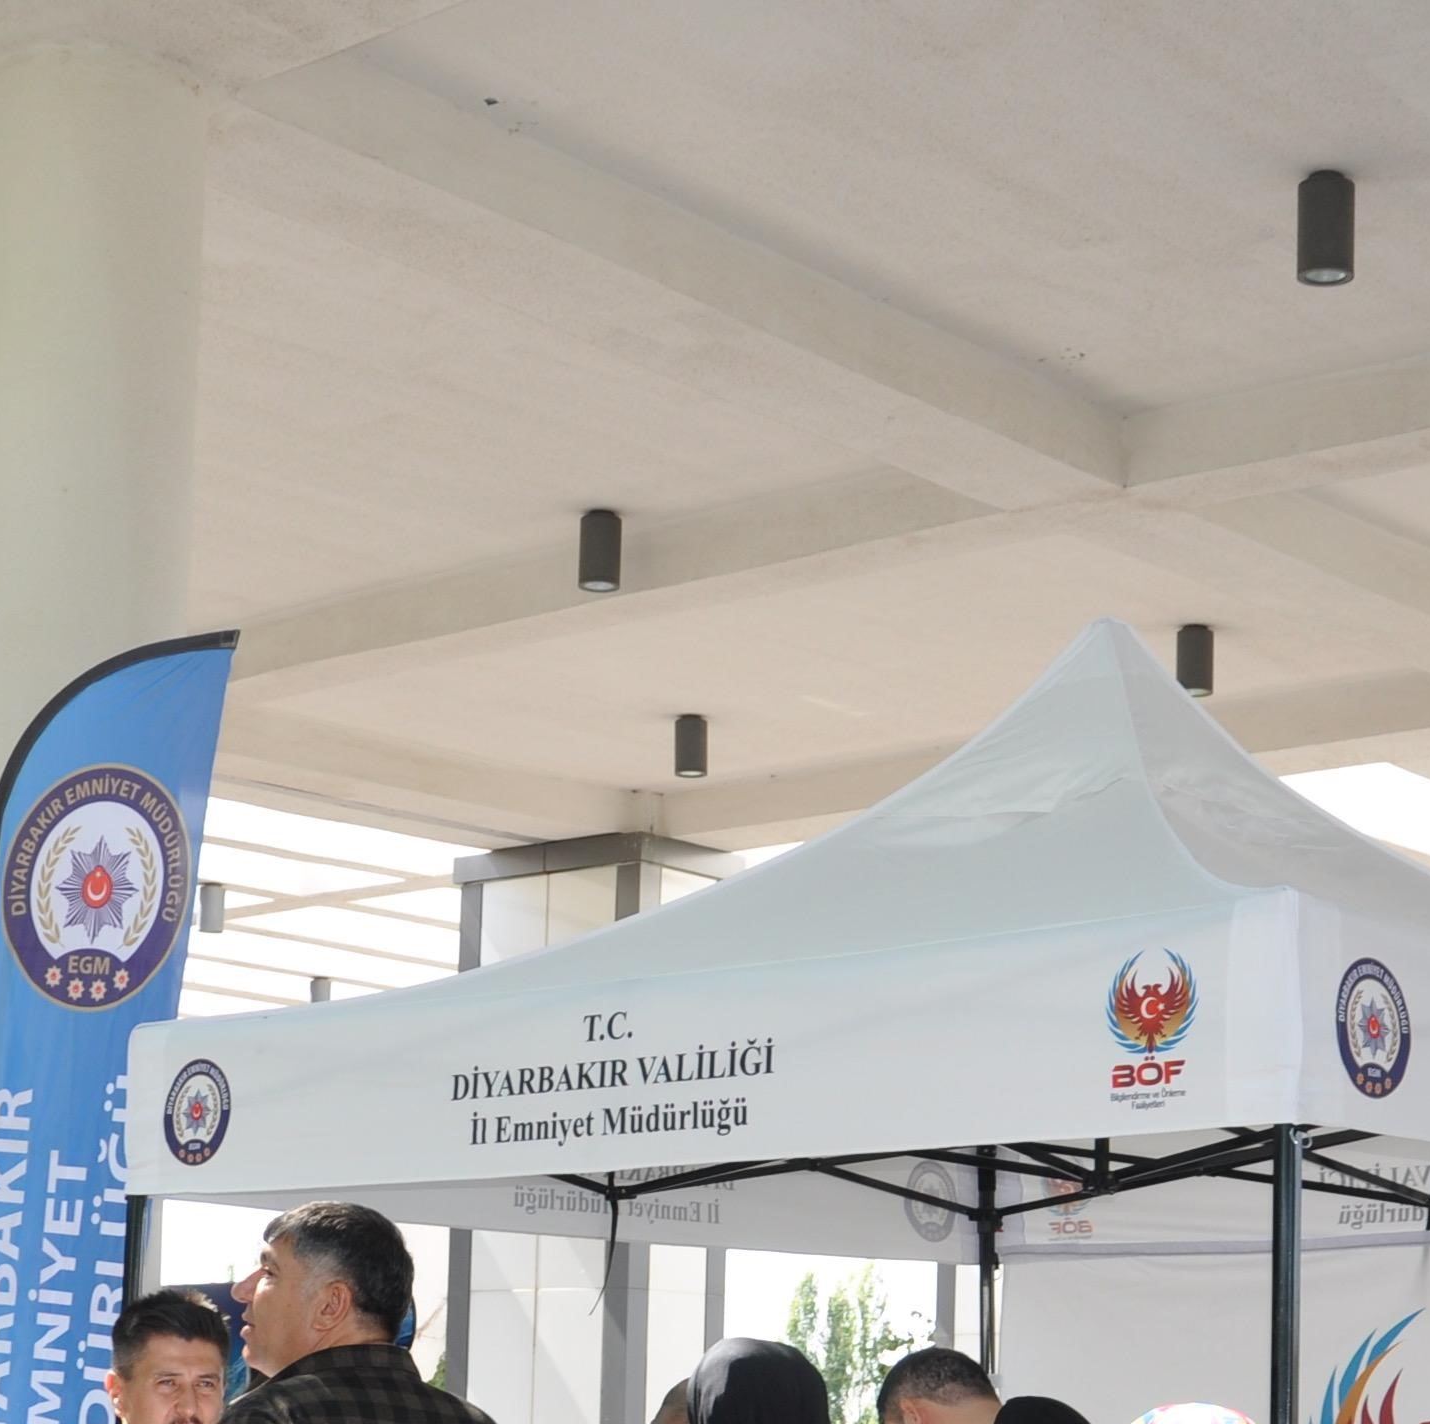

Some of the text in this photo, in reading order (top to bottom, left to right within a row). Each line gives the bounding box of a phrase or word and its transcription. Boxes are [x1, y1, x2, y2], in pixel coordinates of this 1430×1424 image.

[11, 773, 184, 923] DİYARBAKIR EMNİYET MÜDÜRLÜĞÜ
[68, 955, 111, 976] EGM
[583, 1011, 634, 1043] T.C.
[451, 1037, 776, 1101] DİYARBAKIR VALİLİĞİ
[1111, 1055, 1186, 1088] BÖF
[469, 1096, 749, 1147] İl Emniyet Müdürlüğü
